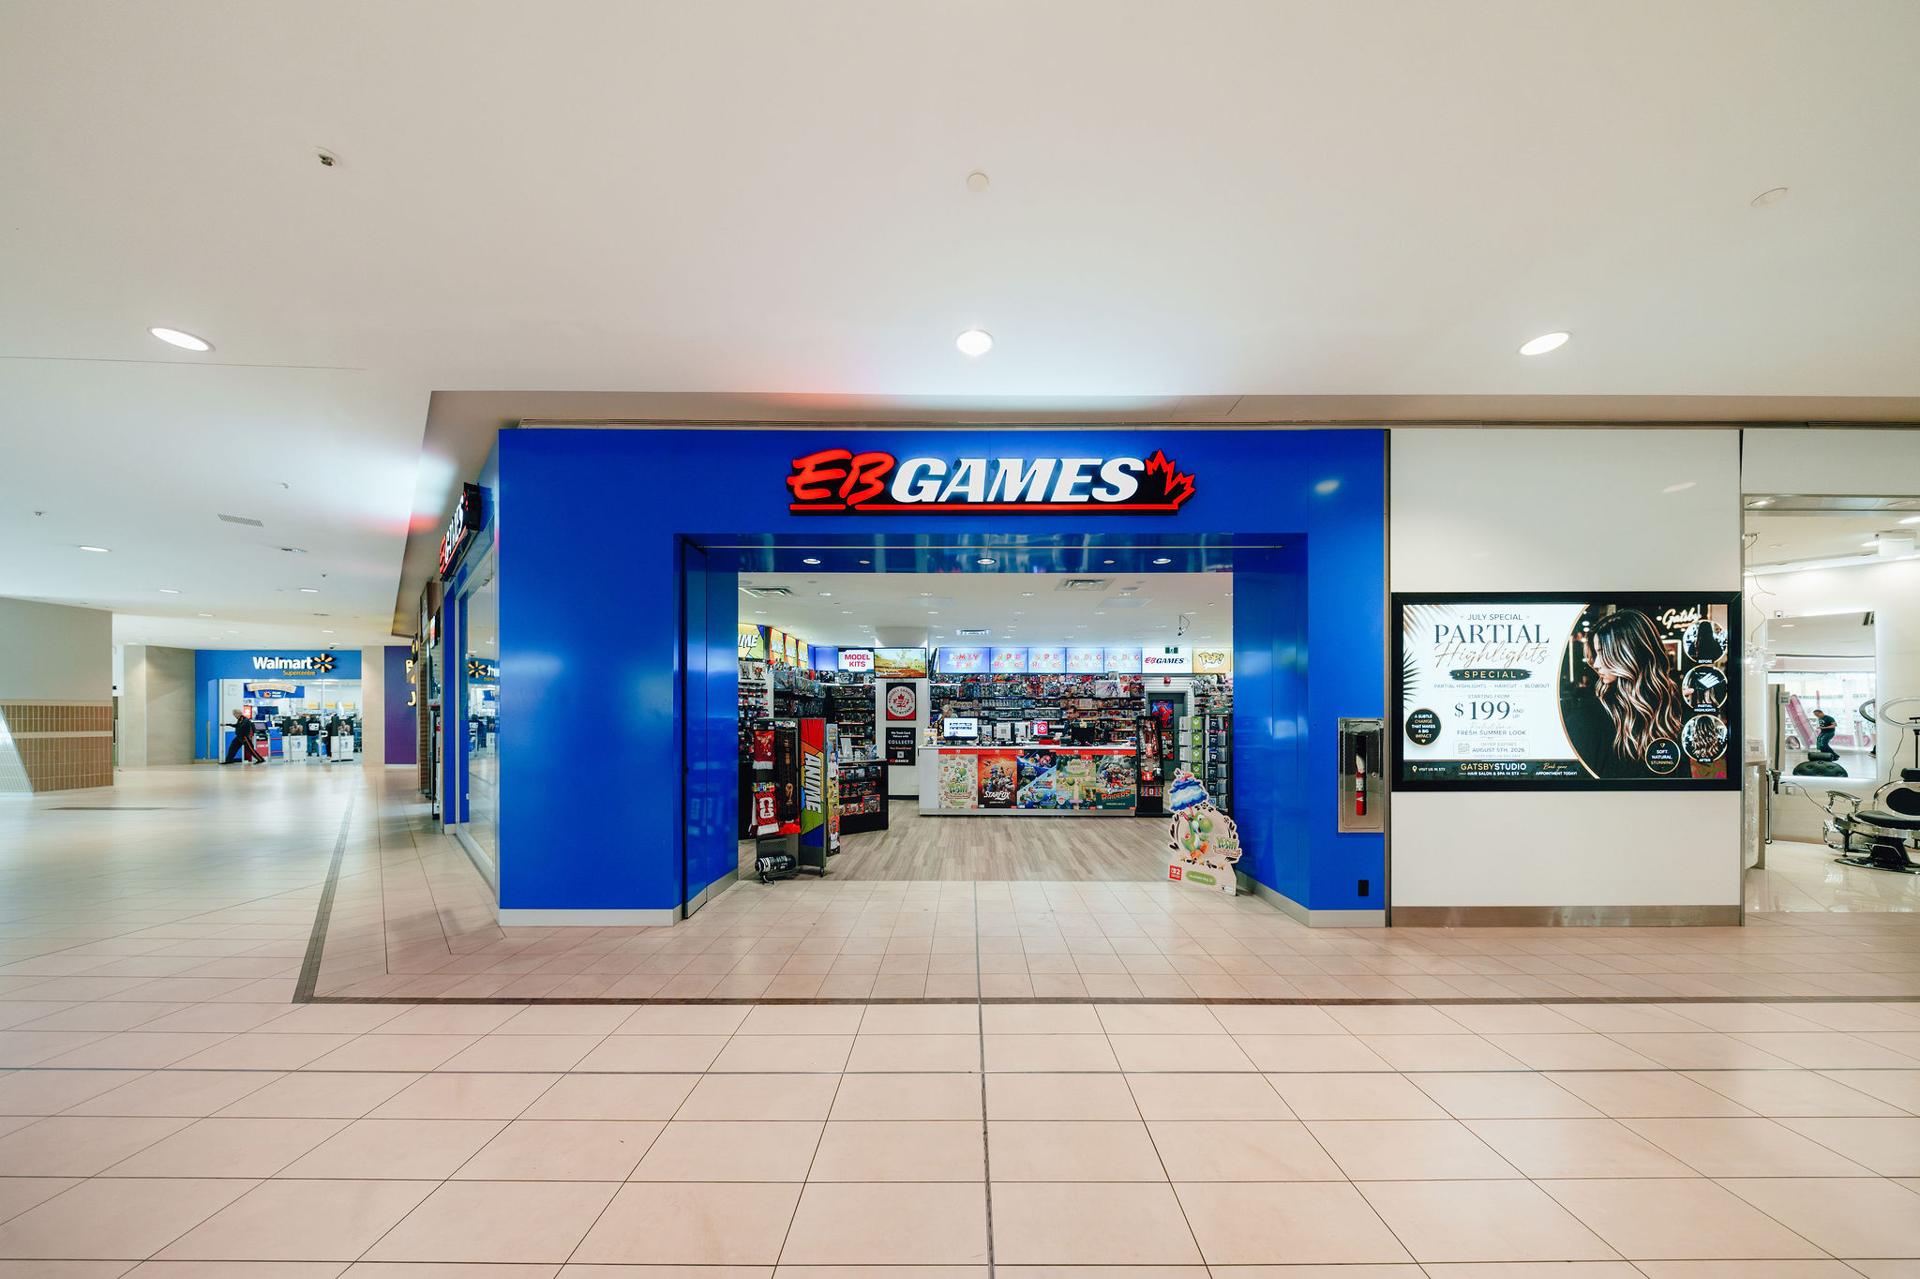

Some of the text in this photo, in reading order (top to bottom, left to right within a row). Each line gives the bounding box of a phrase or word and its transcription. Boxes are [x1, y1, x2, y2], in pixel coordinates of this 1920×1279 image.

[889, 457, 1145, 503] GAMES
[1434, 624, 1550, 644] PARTIAL
[252, 656, 313, 670] Walmart
[1434, 640, 1551, 669] Highlights
[1463, 670, 1517, 679] SPECIAL
[804, 752, 822, 814] ANIME
